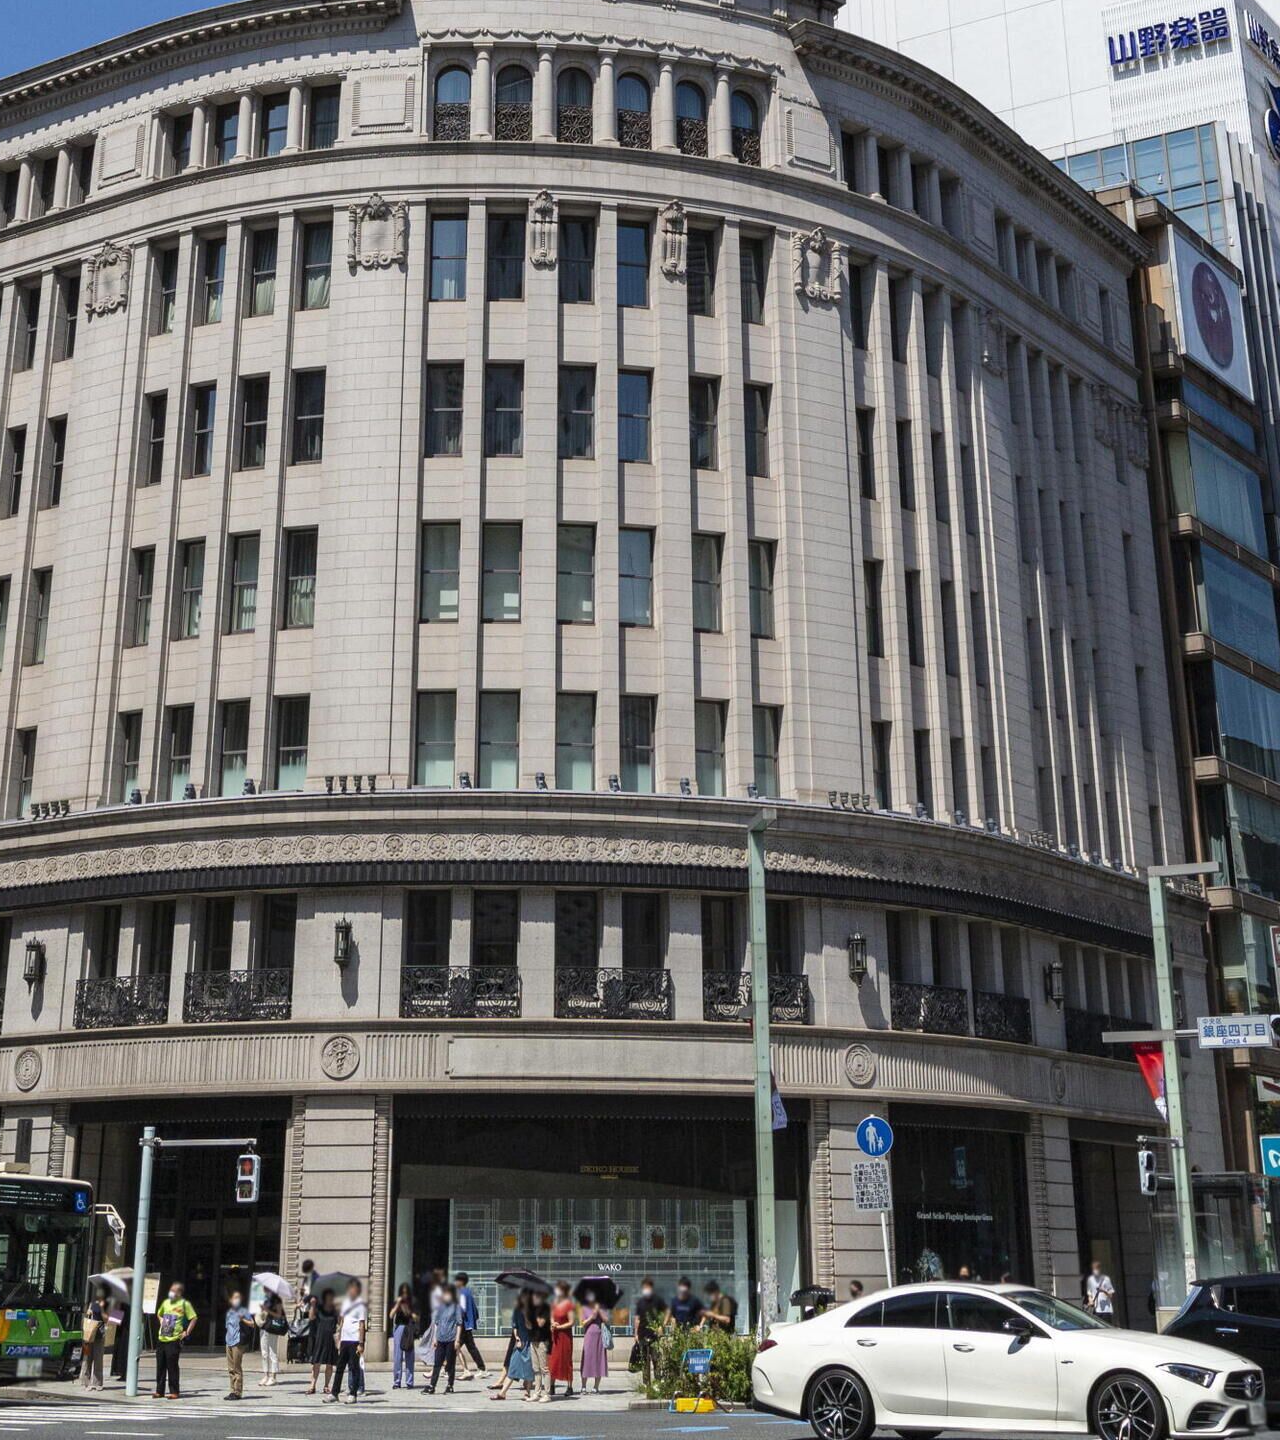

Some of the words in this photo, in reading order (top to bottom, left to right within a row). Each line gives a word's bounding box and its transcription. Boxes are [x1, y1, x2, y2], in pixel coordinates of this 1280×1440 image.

[1108, 7, 1229, 66] 山野楽器
[1203, 1024, 1266, 1038] 銀座四丁目
[1221, 1038, 1241, 1046] Ginza
[597, 1263, 622, 1271] WAKO
